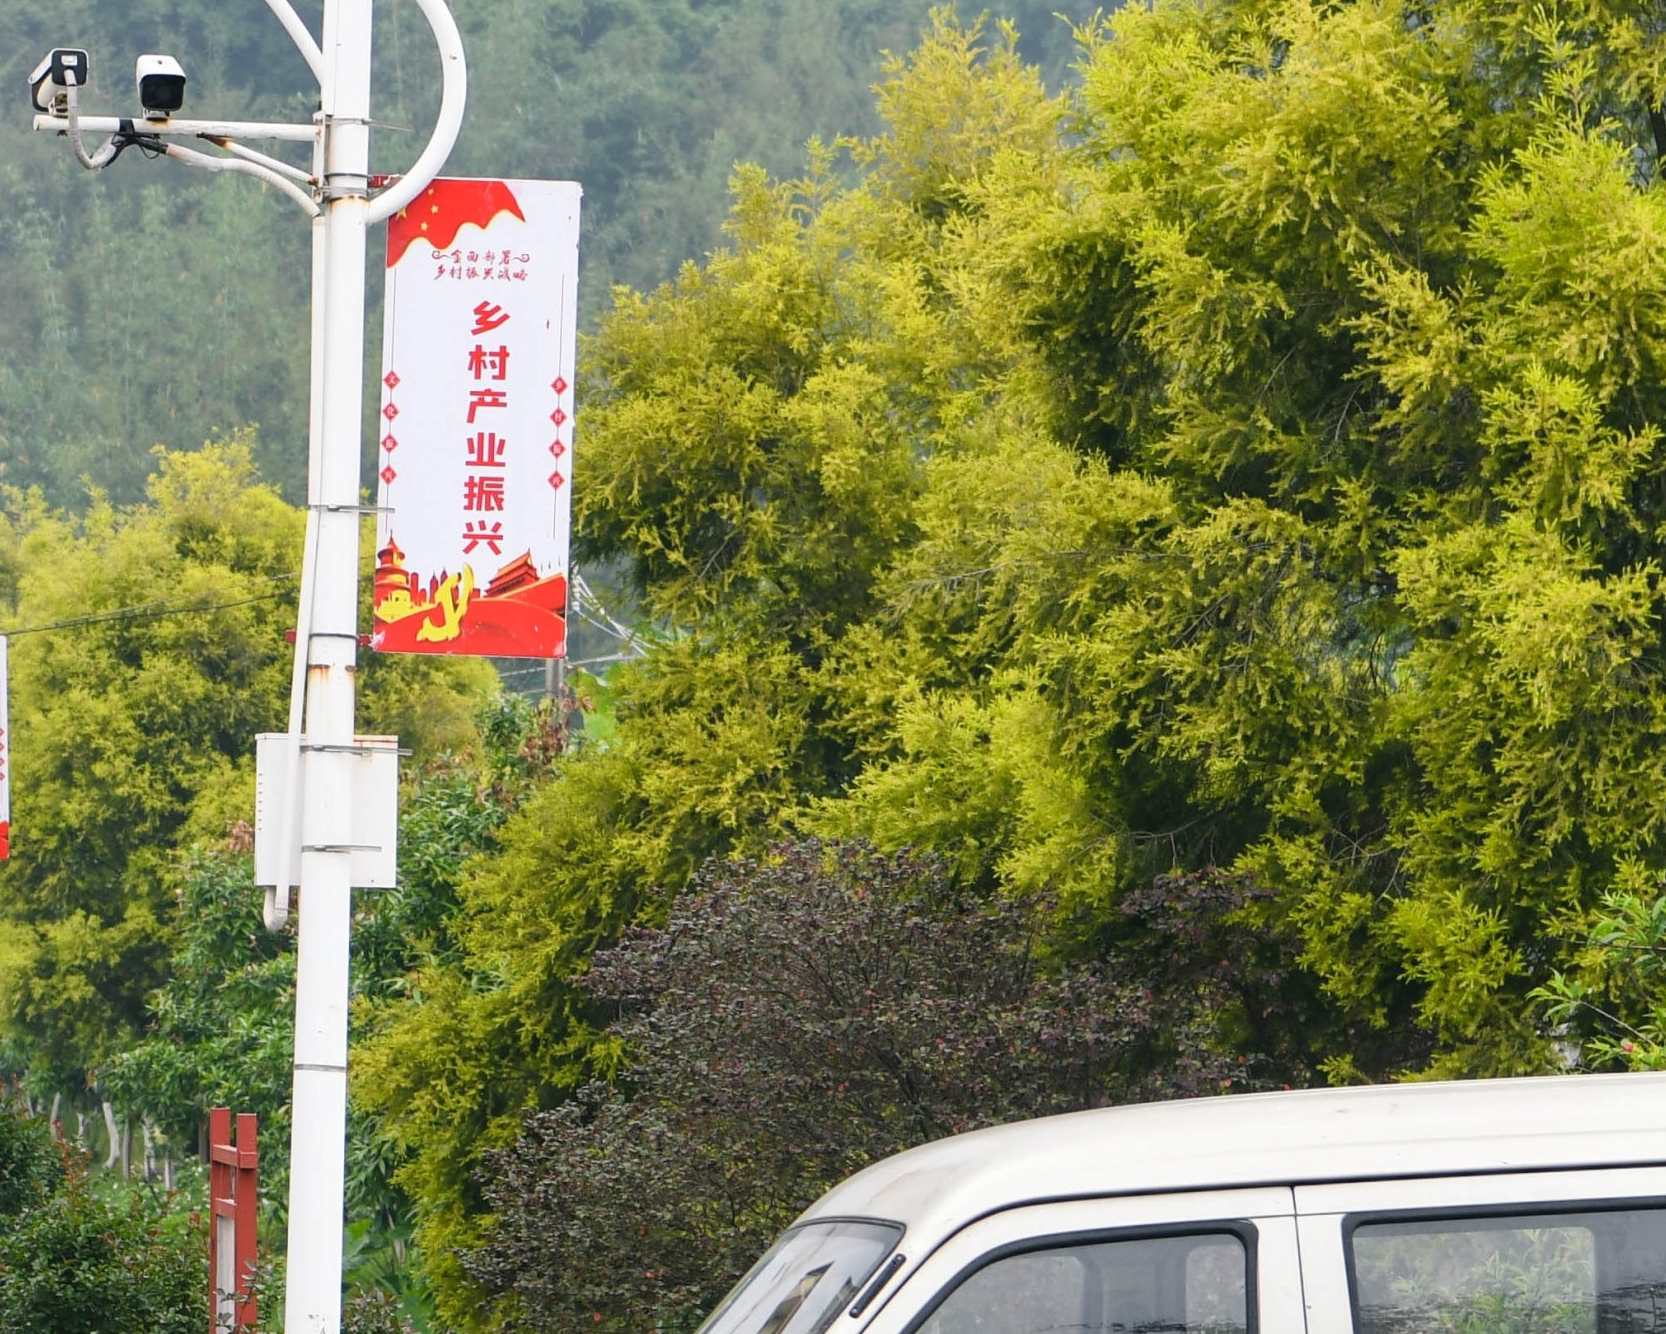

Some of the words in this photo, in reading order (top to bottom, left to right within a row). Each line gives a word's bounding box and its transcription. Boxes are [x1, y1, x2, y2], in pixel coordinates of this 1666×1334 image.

[462, 300, 510, 556] 乡村产业振兴
